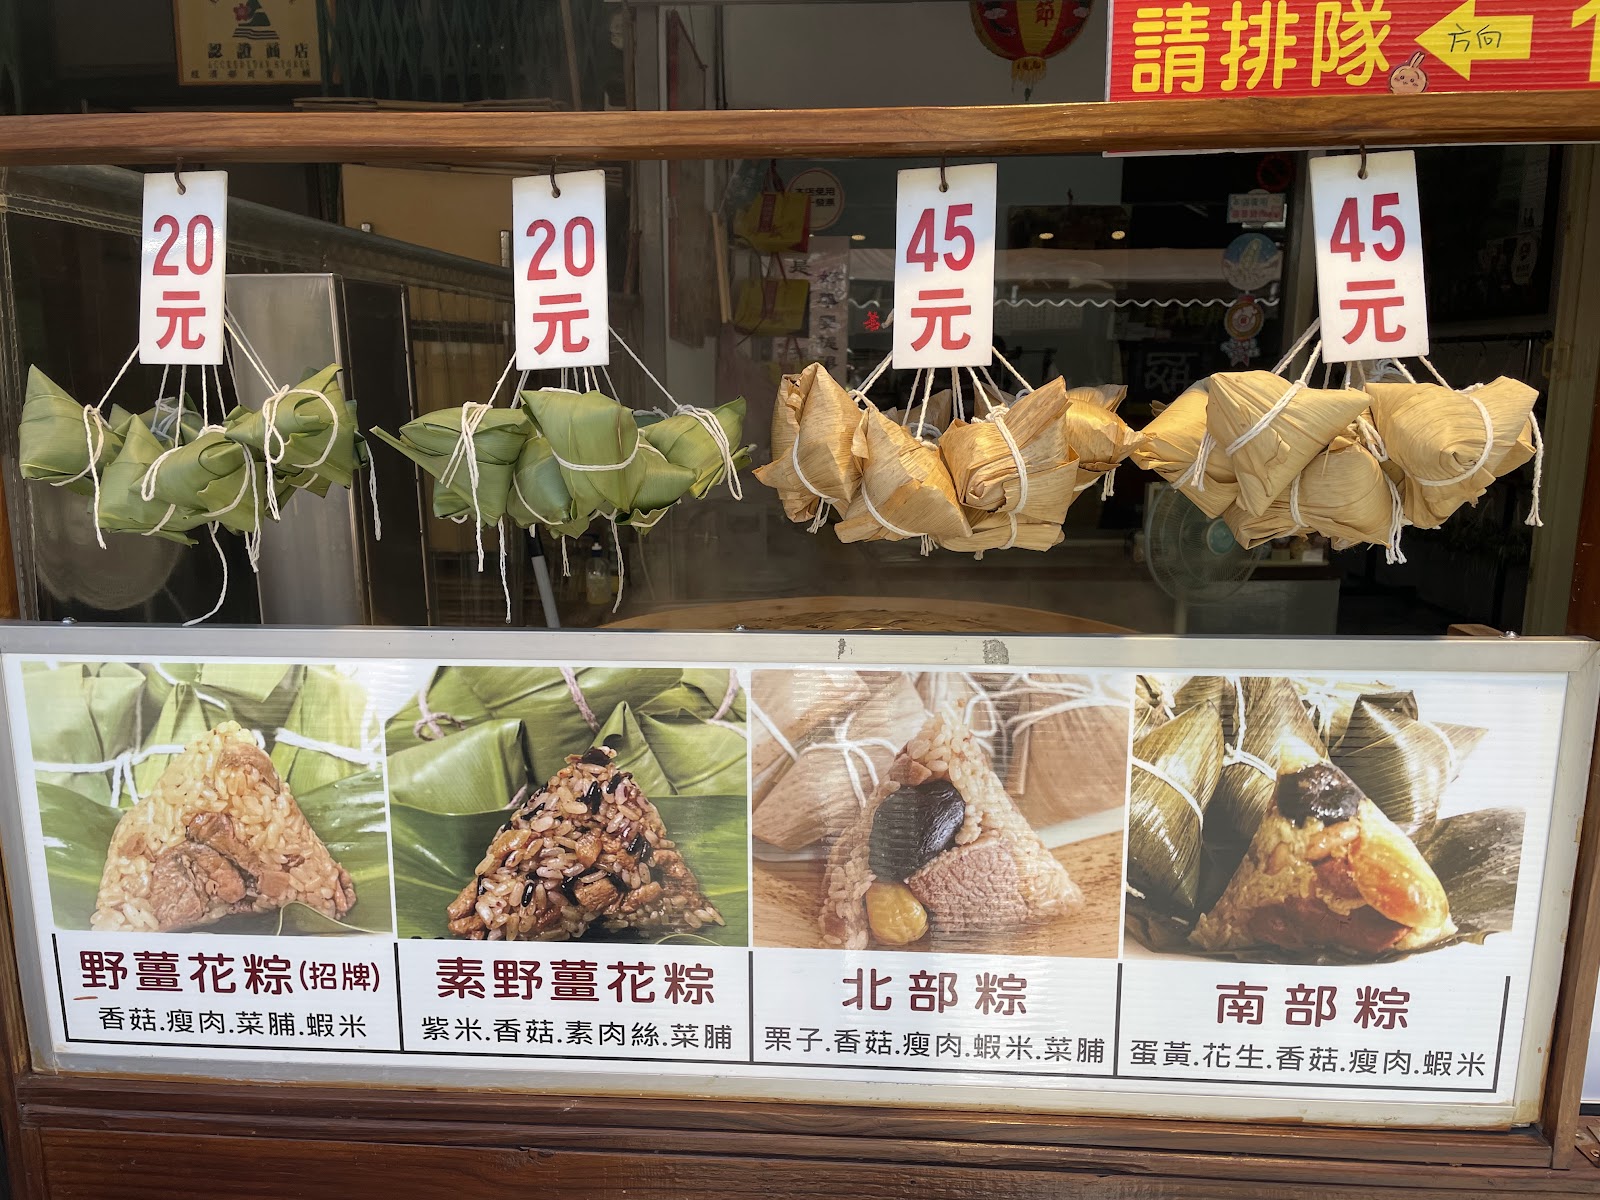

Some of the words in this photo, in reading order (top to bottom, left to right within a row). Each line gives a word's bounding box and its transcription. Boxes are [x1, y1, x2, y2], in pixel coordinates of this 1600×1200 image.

[1132, 0, 1391, 93] 請排隊
[1447, 23, 1502, 53] 方向
[152, 214, 214, 275] 20
[526, 216, 595, 281] 20
[906, 203, 975, 272] 45
[1330, 192, 1406, 263] 45
[156, 291, 206, 350] 元
[532, 293, 590, 355] 元
[911, 288, 971, 351] 元
[1340, 279, 1407, 345] 元
[79, 950, 380, 995] 野薑花粽(招牌)
[436, 956, 715, 1005] 素野薑花粽
[842, 967, 1028, 1016] 北部粽
[98, 1006, 367, 1039] 香菇.瘦肉.菜脯.蝦米
[421, 1015, 733, 1050] 紫米.香菇.素肉絲.菜脯
[1216, 981, 1411, 1030] 南部粽
[764, 1026, 1106, 1064] 栗子.香菇.瘦肉.蝦米.菜脯
[1129, 1039, 1486, 1078] 蛋黃.花生.香菇.瘦肉.蝦米
